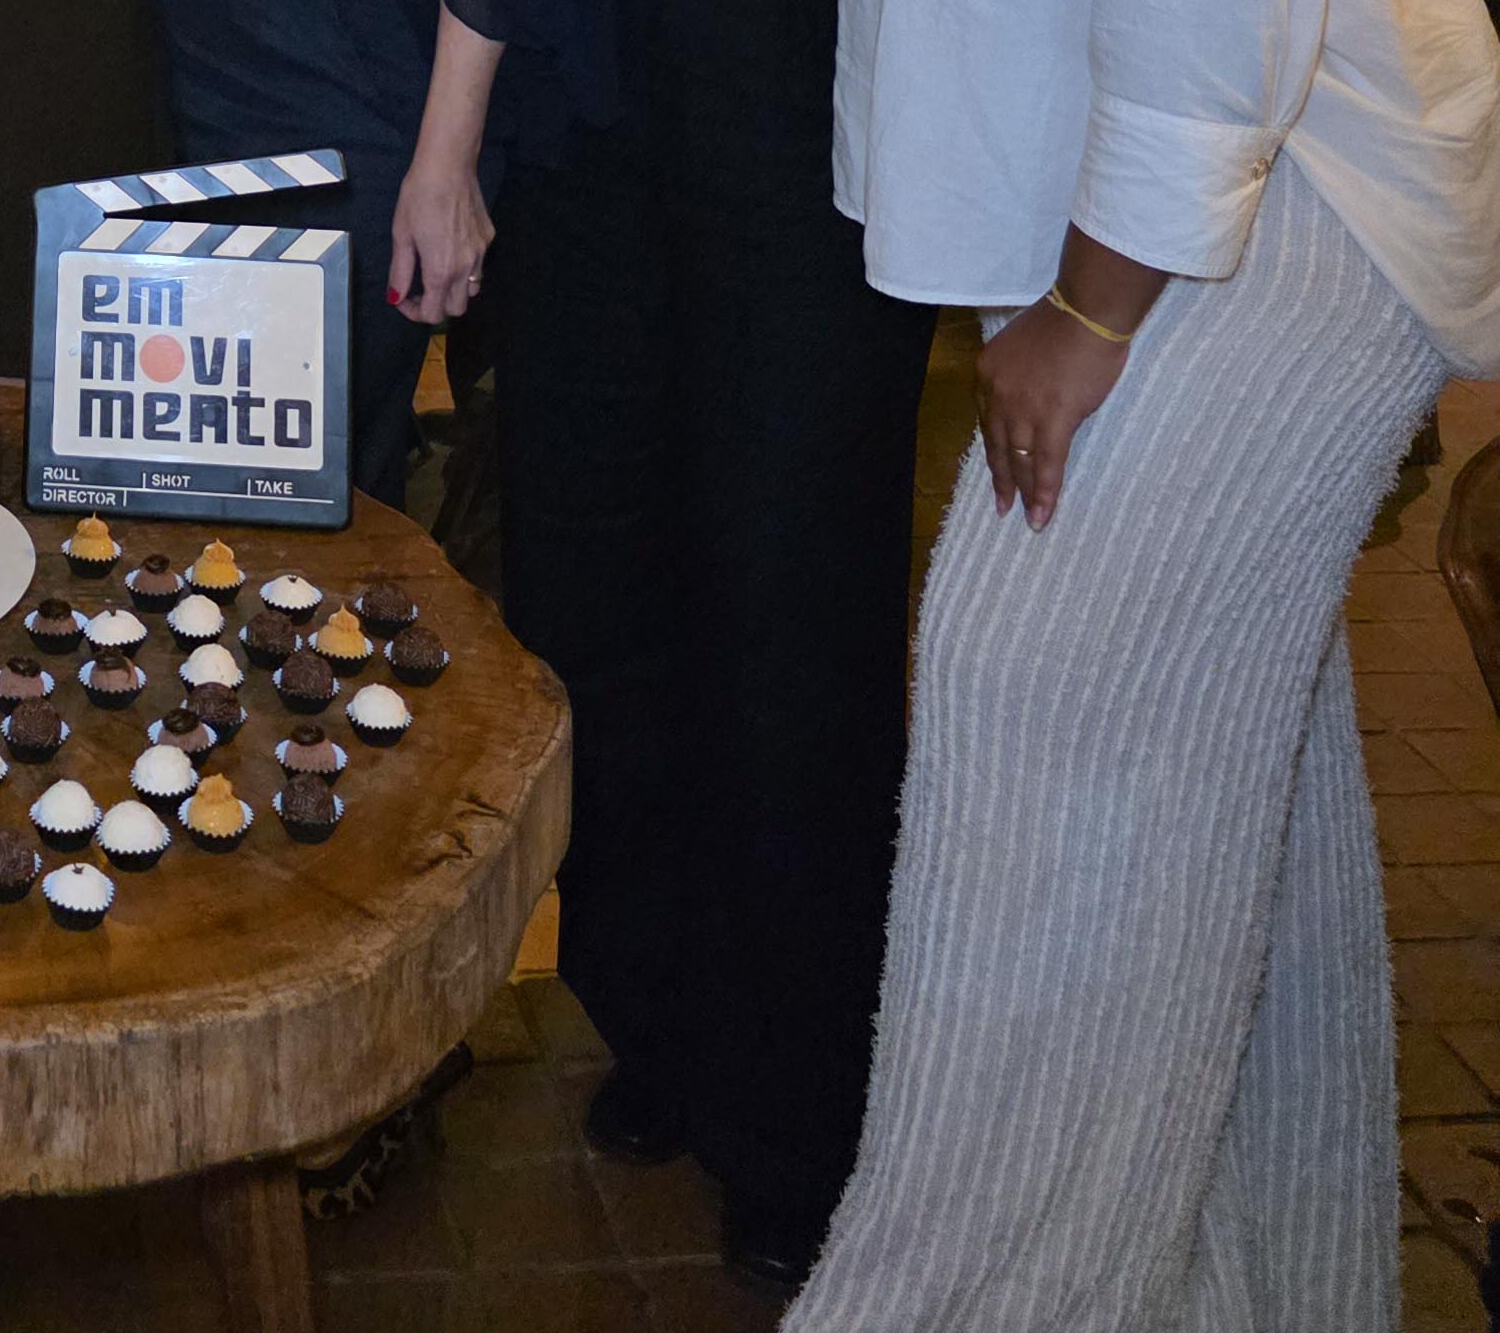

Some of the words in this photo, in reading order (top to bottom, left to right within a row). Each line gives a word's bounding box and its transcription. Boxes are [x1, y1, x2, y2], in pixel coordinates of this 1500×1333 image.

[82, 274, 184, 327] em
[78, 388, 312, 449] mento
[42, 489, 117, 506] DIRECTOR
[43, 467, 81, 482] ROLL
[151, 473, 191, 488] SHOT
[255, 480, 293, 495] TAKE
